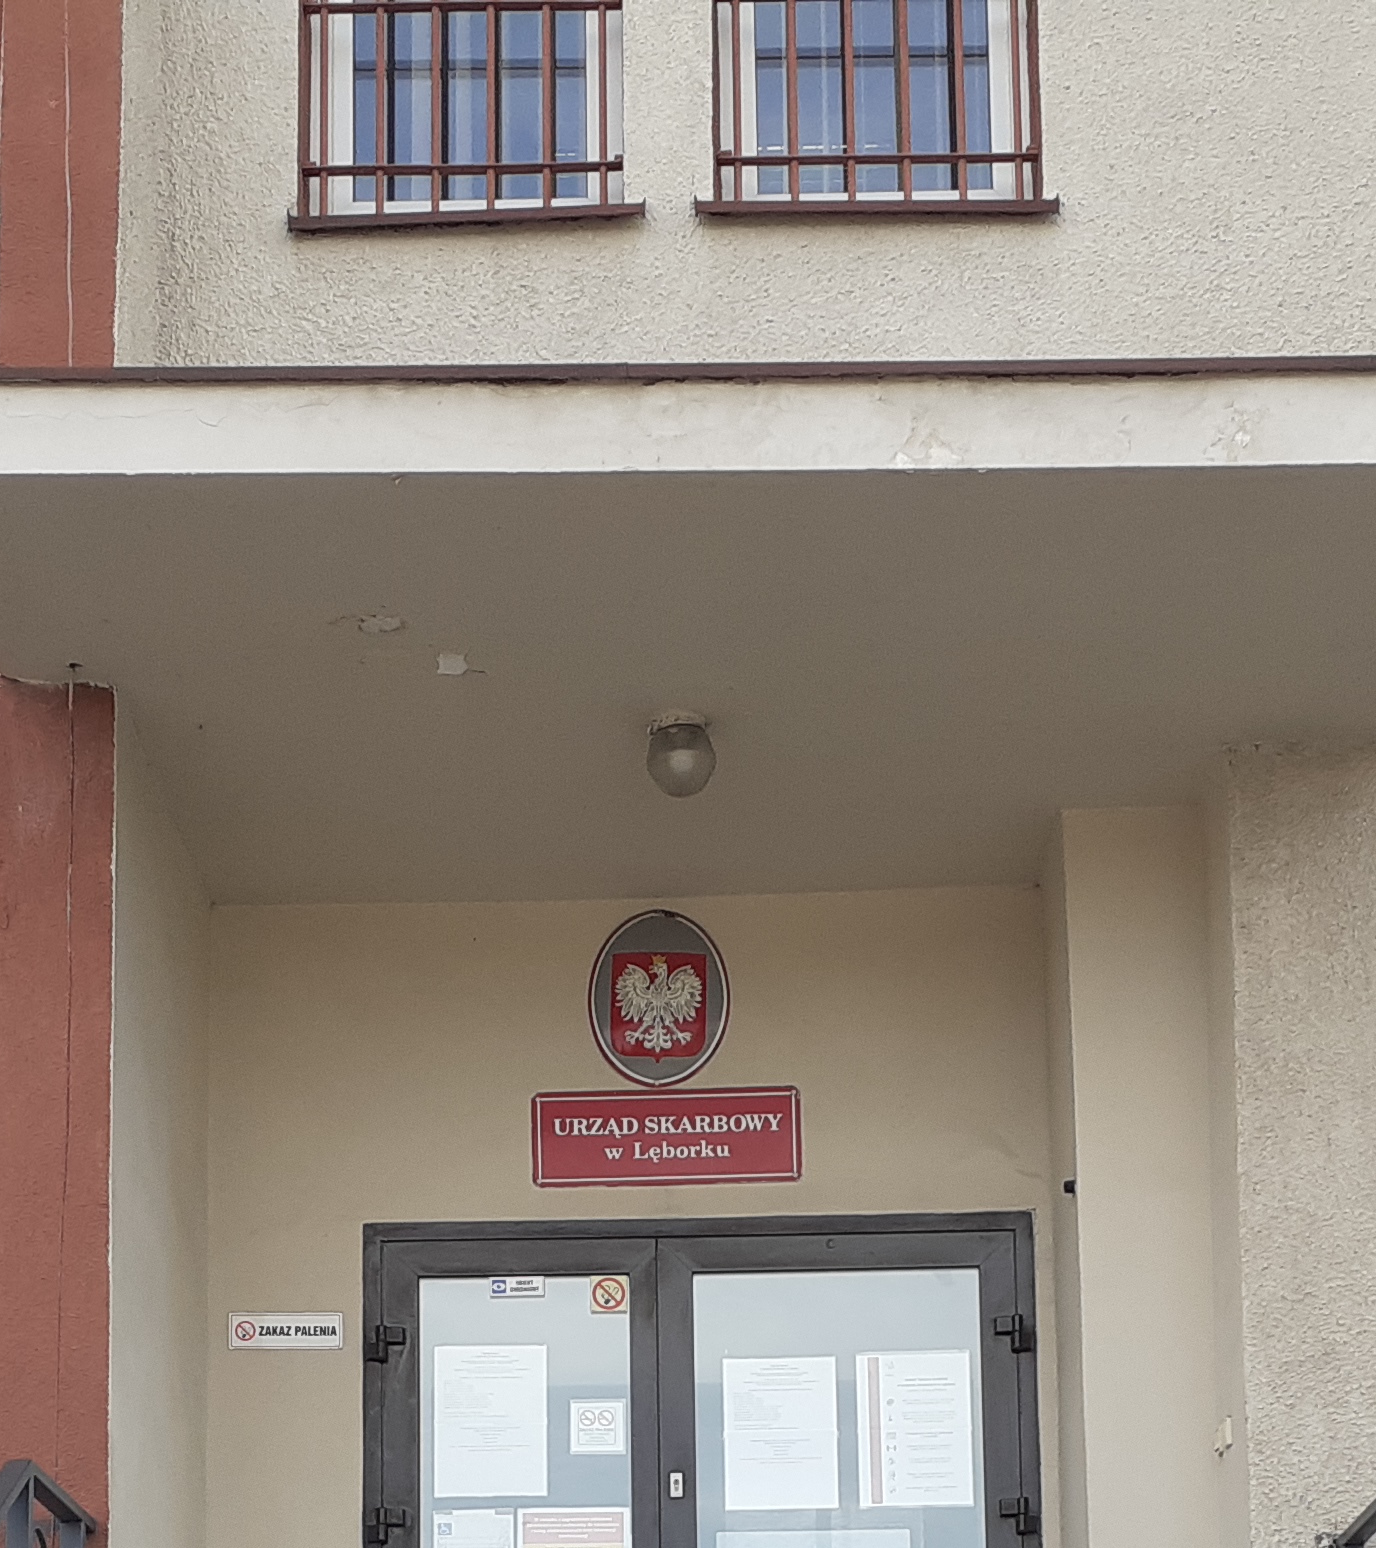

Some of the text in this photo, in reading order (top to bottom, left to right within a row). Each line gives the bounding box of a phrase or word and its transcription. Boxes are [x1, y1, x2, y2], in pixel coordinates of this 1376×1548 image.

[553, 1113, 783, 1139] URZĄD SKARBOWY
[604, 1140, 730, 1163] w Lęborku
[258, 1325, 337, 1336] ZAKAZ PALENIA
